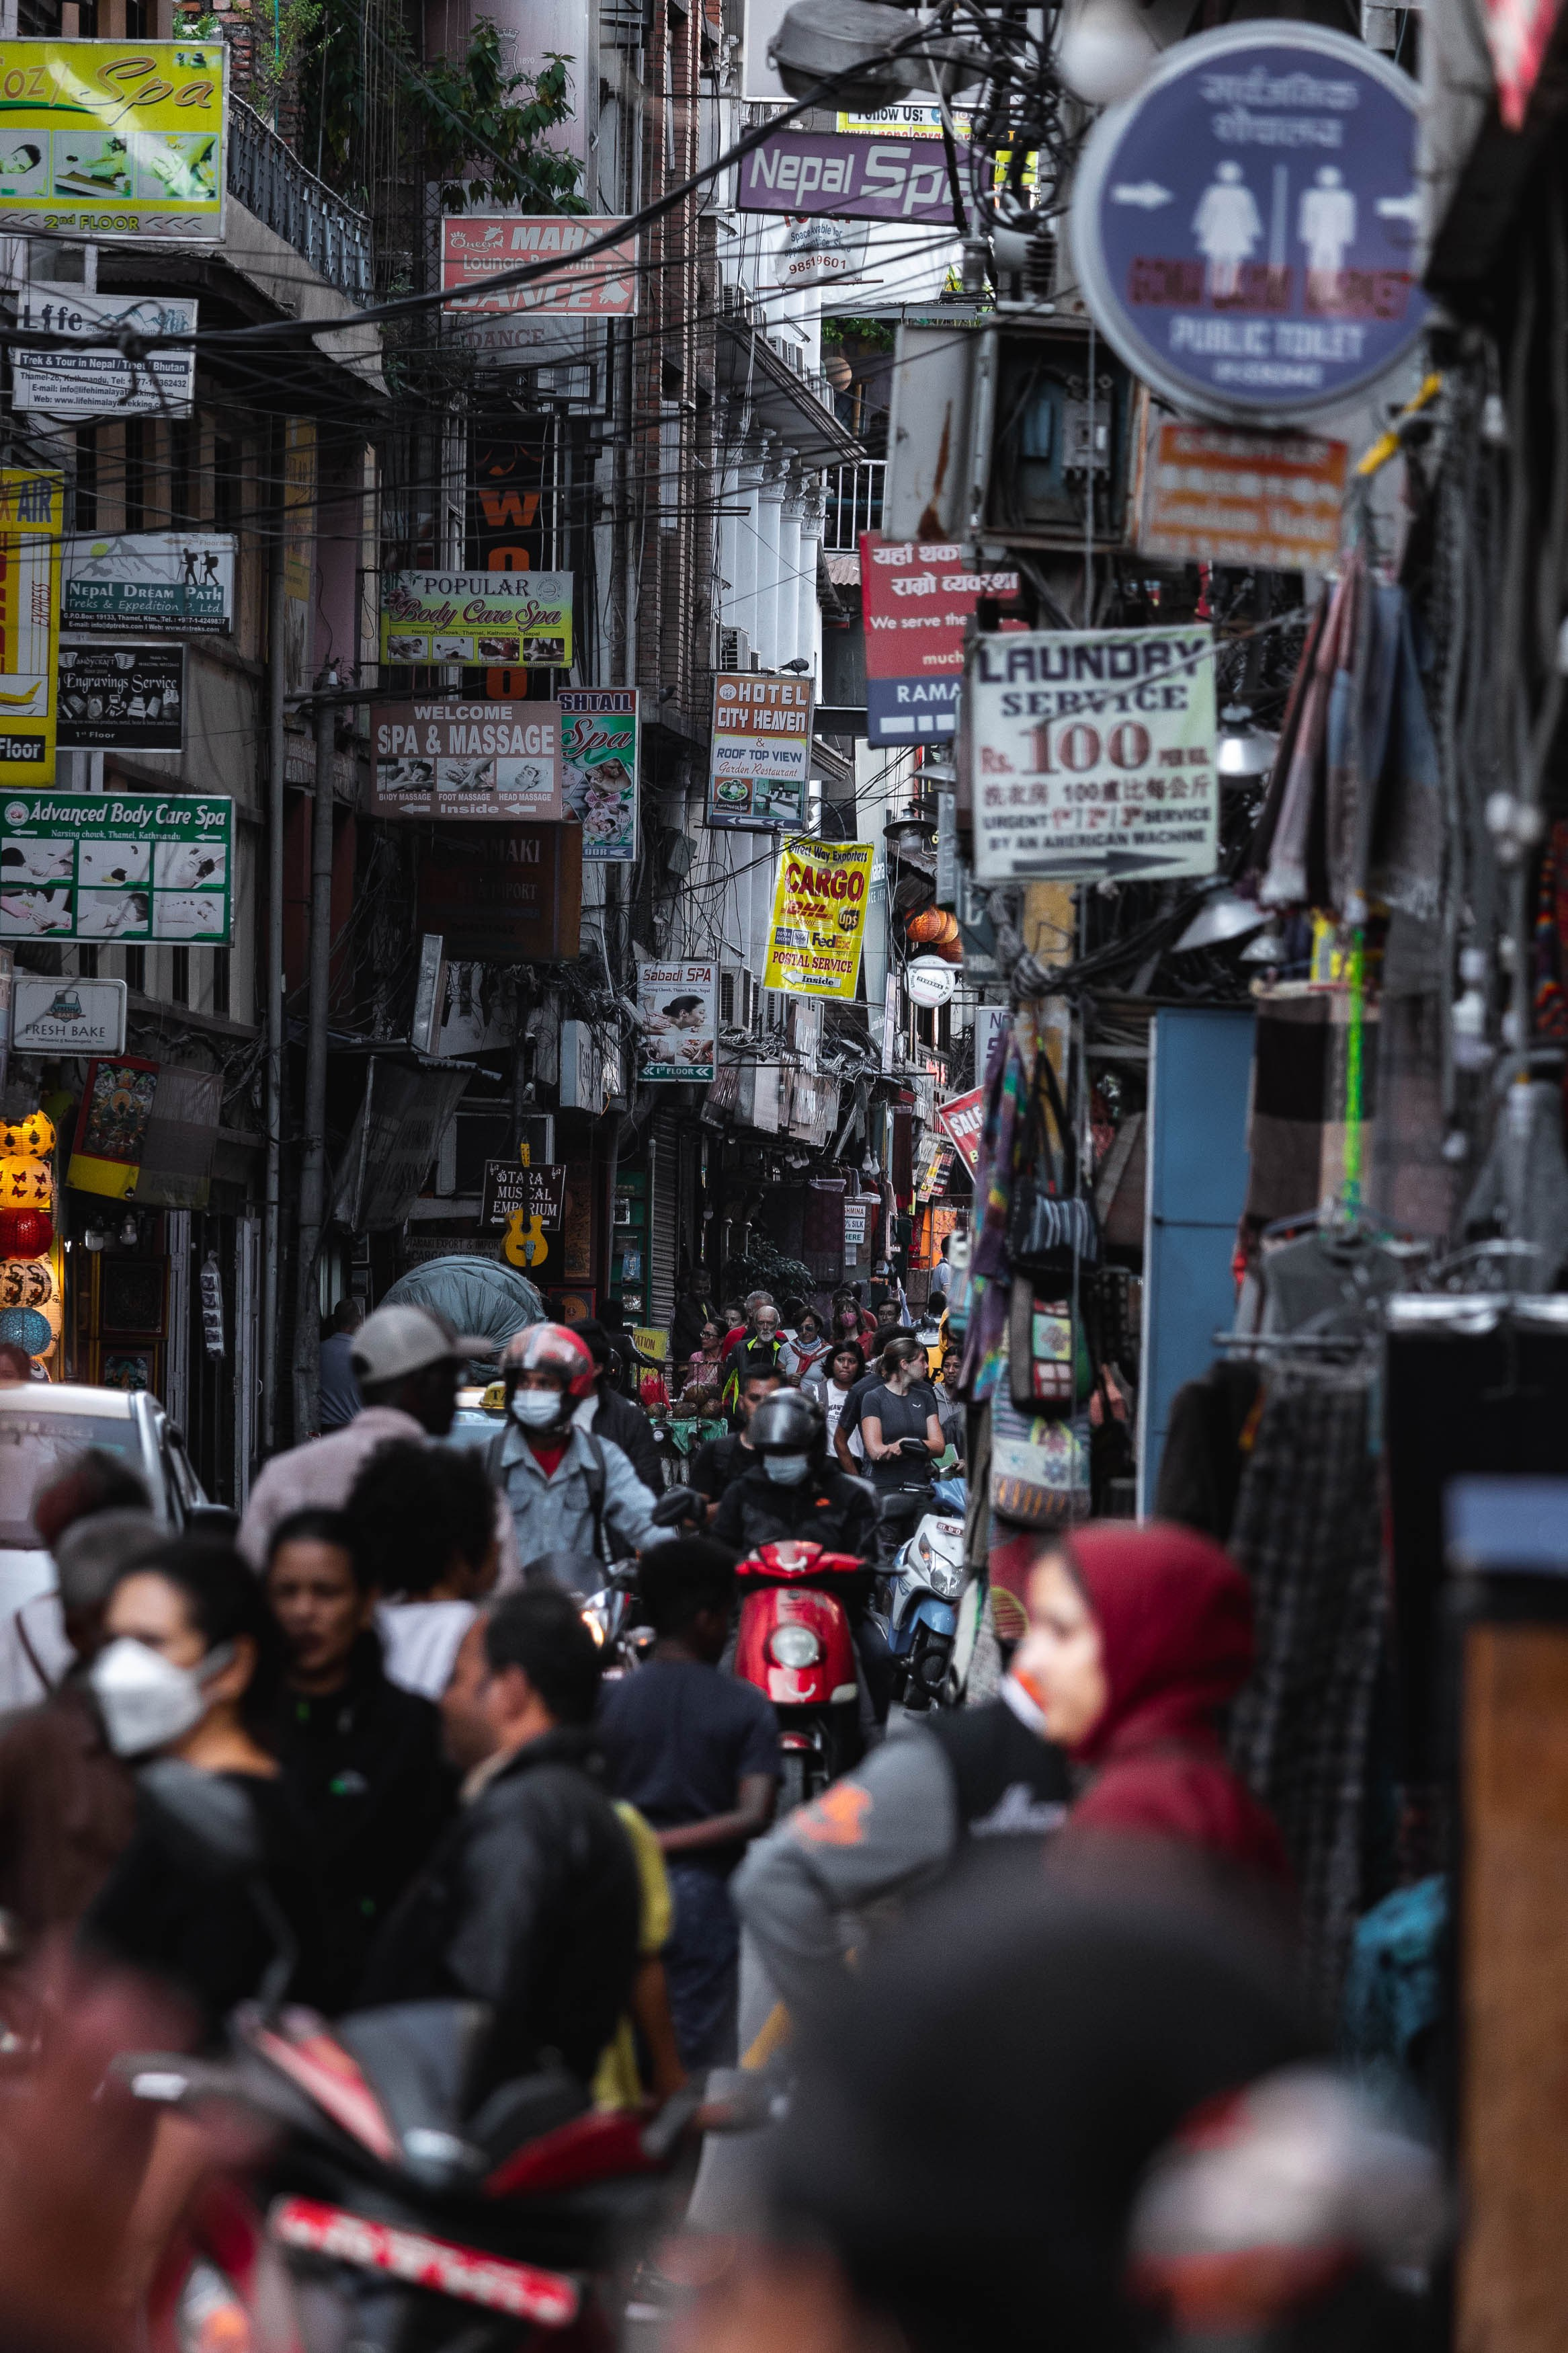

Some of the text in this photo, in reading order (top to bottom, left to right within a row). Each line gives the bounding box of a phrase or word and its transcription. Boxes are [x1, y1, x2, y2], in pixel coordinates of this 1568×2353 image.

[70, 56, 214, 126] Spa
[903, 106, 923, 122] Us:
[749, 147, 854, 206] Nepal
[44, 214, 139, 231] 2nd FLOOR
[511, 227, 620, 251] MAHA
[450, 283, 594, 307] DANCE
[468, 328, 545, 347] DANCE
[23, 355, 44, 366] Trek
[46, 356, 52, 366] &
[55, 356, 76, 367] Tour
[79, 358, 87, 367] in
[89, 358, 116, 371] Nepal
[153, 360, 185, 372] Bhutan
[32, 384, 58, 393] E-mail:
[112, 376, 126, 385] Tel:
[34, 395, 52, 403] Web:
[17, 479, 52, 523] AIR
[424, 577, 531, 597] POPULAR
[31, 580, 51, 628] EXPRESS
[68, 598, 97, 609] Treks
[104, 600, 114, 609] &
[118, 600, 179, 615] Expedition
[390, 598, 562, 631] Body Care Spa
[870, 612, 968, 630] We serve the
[922, 650, 964, 666] much
[979, 639, 1206, 684] LAUNDRY
[131, 674, 177, 693] Service
[739, 682, 807, 706] HOTEL
[1001, 684, 1188, 717] SERVICE
[414, 705, 513, 721] WELCOME
[717, 707, 749, 728] CITY
[89, 731, 116, 739] Floor
[377, 725, 554, 755] SPA & MASSAGE
[561, 718, 633, 758] Spa
[756, 737, 765, 748] &
[716, 748, 802, 764] ROOF TOP VIEW
[1019, 720, 1152, 776] 100
[719, 761, 798, 777] Garden Restaurant
[379, 793, 431, 801] BODY MASSAGE
[438, 793, 491, 802] FOOT MASSAGE
[499, 793, 551, 802] HEAD MASSAGE
[29, 799, 108, 827] Advanced
[110, 802, 153, 828] Body
[155, 803, 192, 825] Care
[194, 805, 226, 830] Spa
[440, 803, 499, 815] Inside
[583, 848, 607, 856] OOR
[814, 846, 830, 863] Way
[832, 850, 868, 865] Exporters
[784, 862, 865, 903] CARGO
[786, 900, 828, 920] DHL
[841, 914, 858, 929] ups
[812, 932, 851, 950] FedEx
[772, 951, 853, 973] POSTAL SERVICE
[643, 967, 711, 982] Sabadi SPA
[802, 975, 834, 986] Inside
[26, 1024, 106, 1037] FRESH BAKE
[667, 1068, 694, 1076] FLOOR
[497, 1185, 552, 1201] MUSCAL
[852, 1220, 864, 1228] SILK
[437, 1237, 463, 1249] EXPORT
